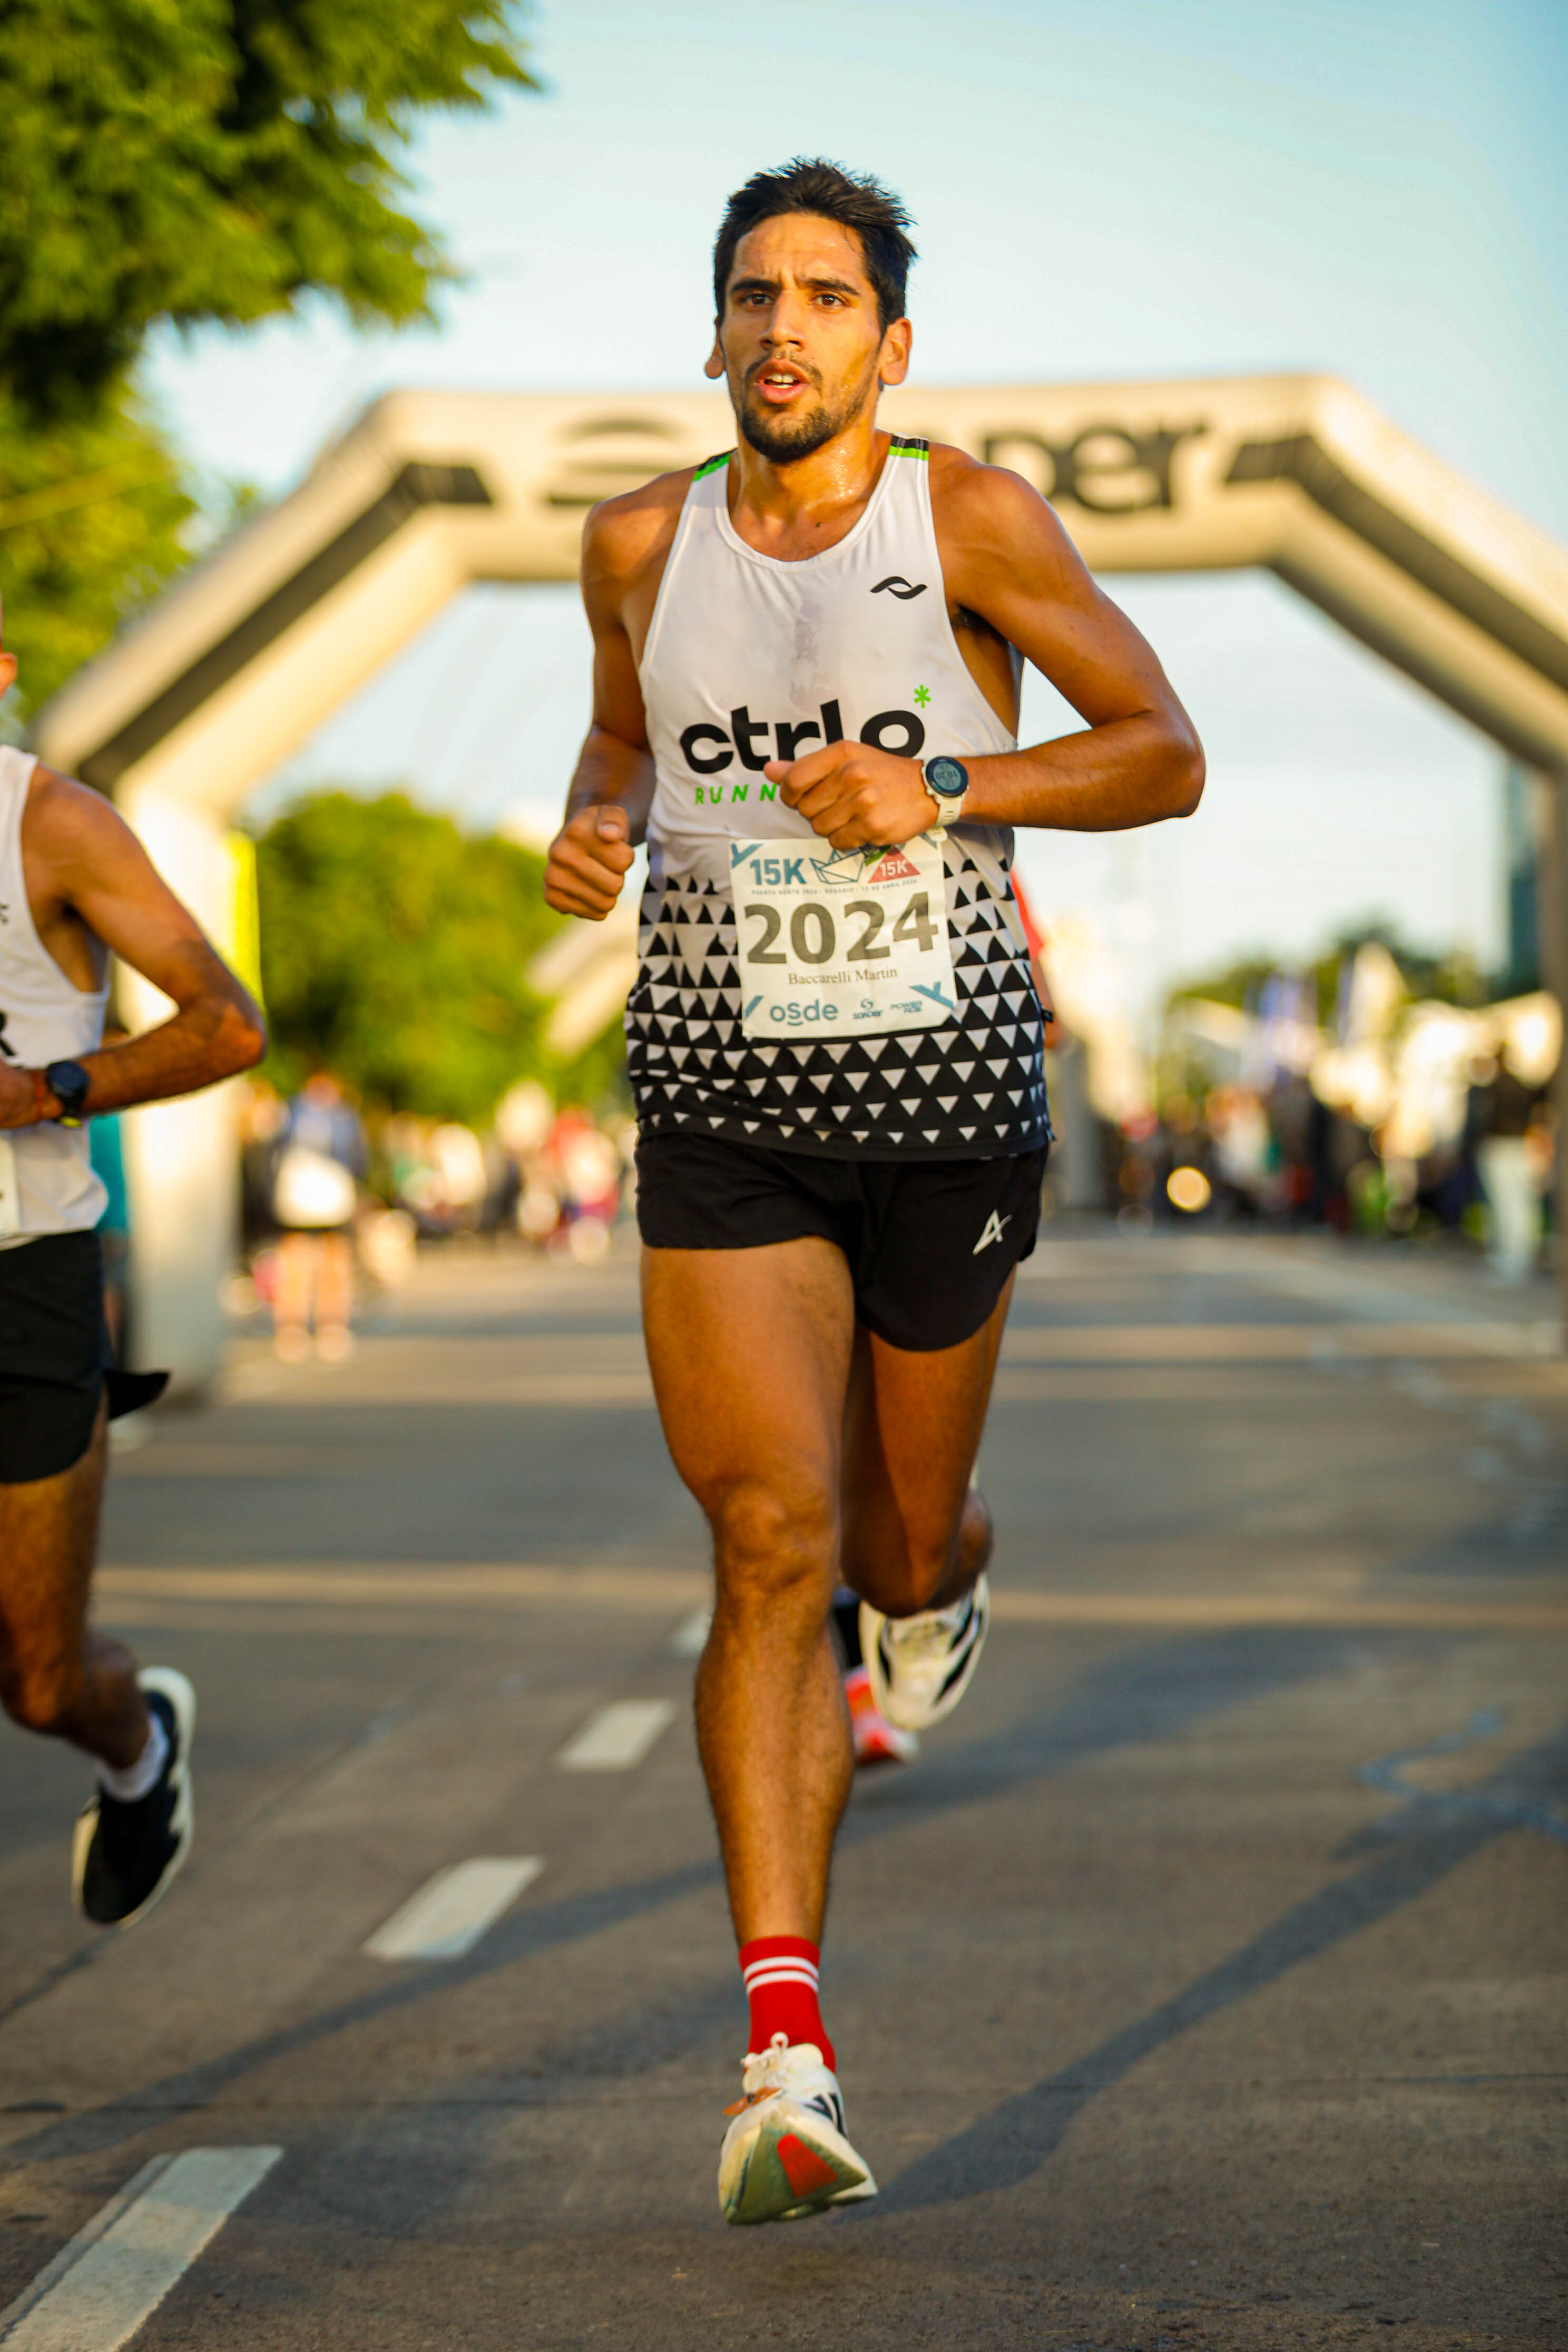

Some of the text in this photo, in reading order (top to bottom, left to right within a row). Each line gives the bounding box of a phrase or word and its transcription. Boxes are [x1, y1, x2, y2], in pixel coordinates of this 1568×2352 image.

[694, 783, 778, 805] RUNN
[750, 858, 807, 885] 15K
[880, 859, 908, 877] 15K
[744, 891, 939, 965] 2024
[788, 967, 898, 985] Baccarelli Martin
[770, 998, 838, 1026] osde
